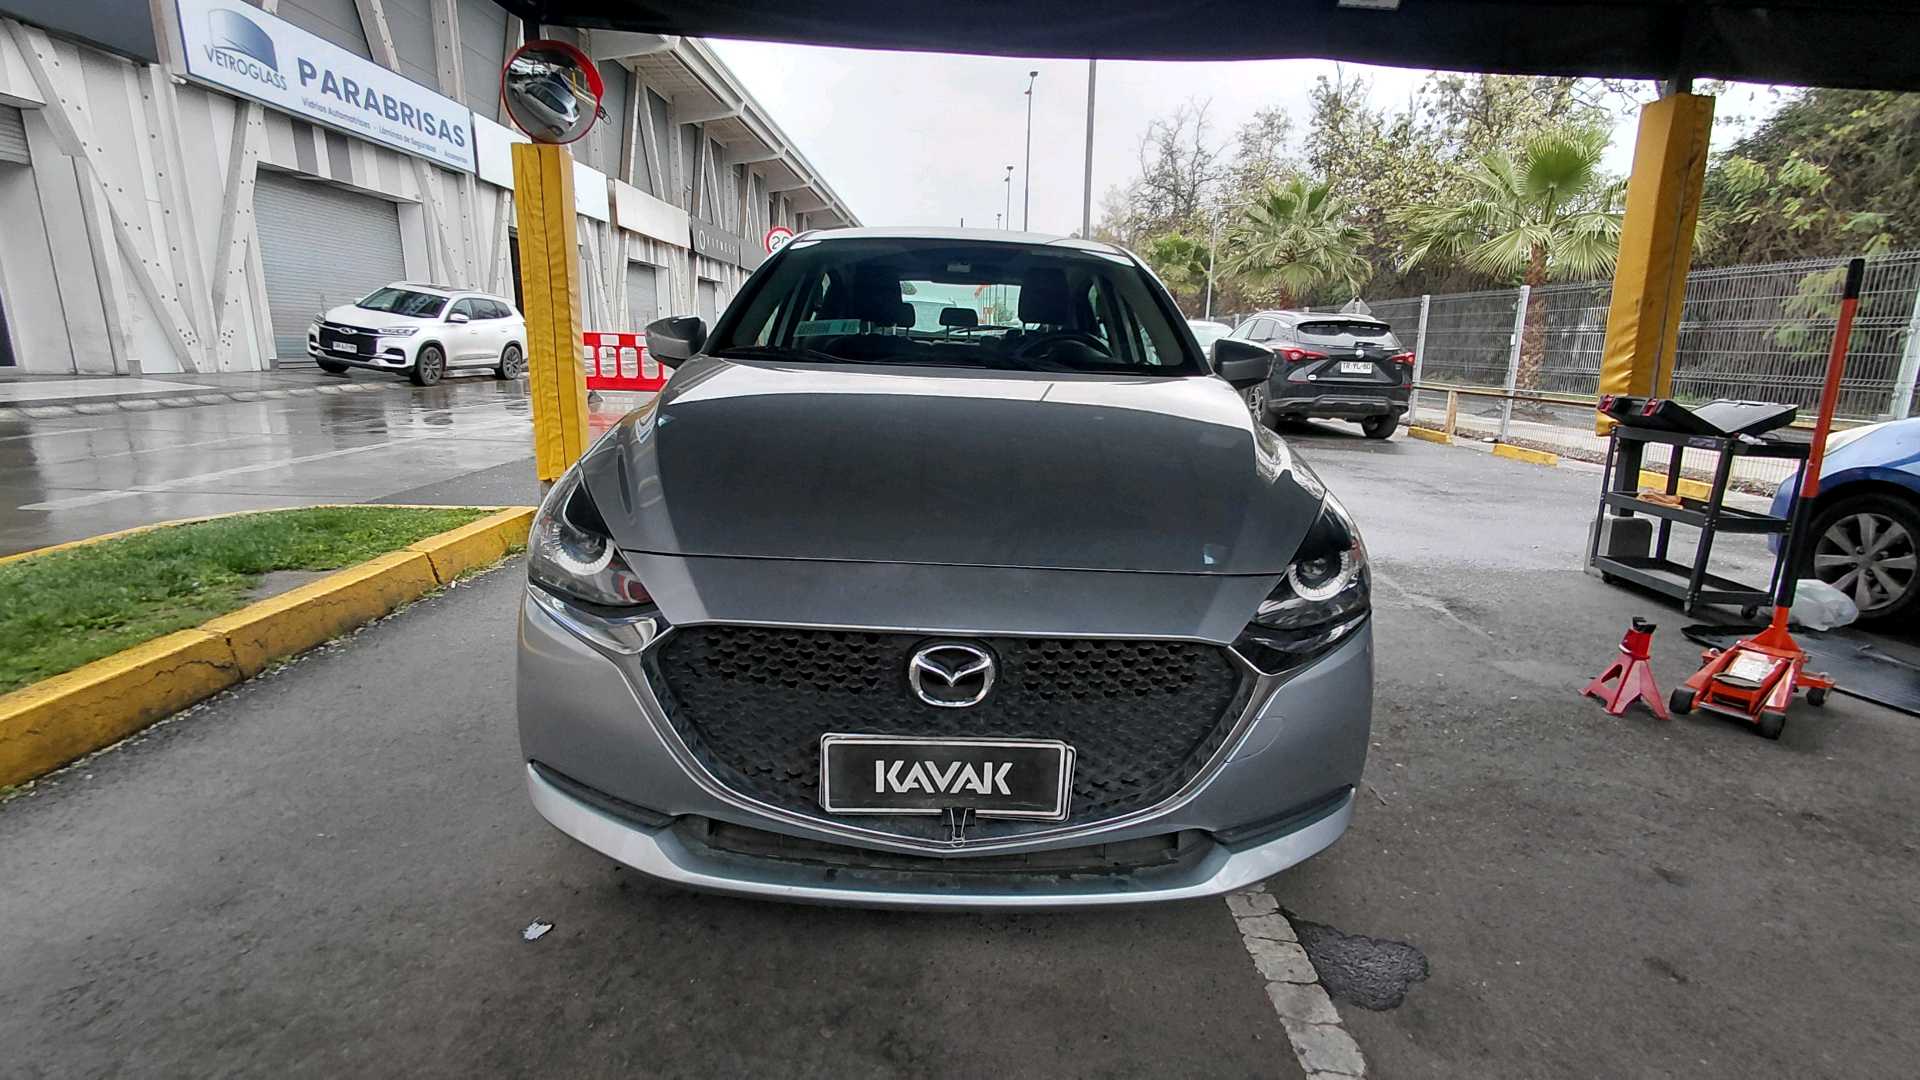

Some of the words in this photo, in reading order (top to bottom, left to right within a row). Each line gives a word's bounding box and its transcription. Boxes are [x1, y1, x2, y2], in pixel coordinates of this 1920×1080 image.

[203, 44, 287, 91] VETROGLASS
[297, 57, 466, 148] PARABRISAS
[875, 760, 1013, 795] KAVAK
